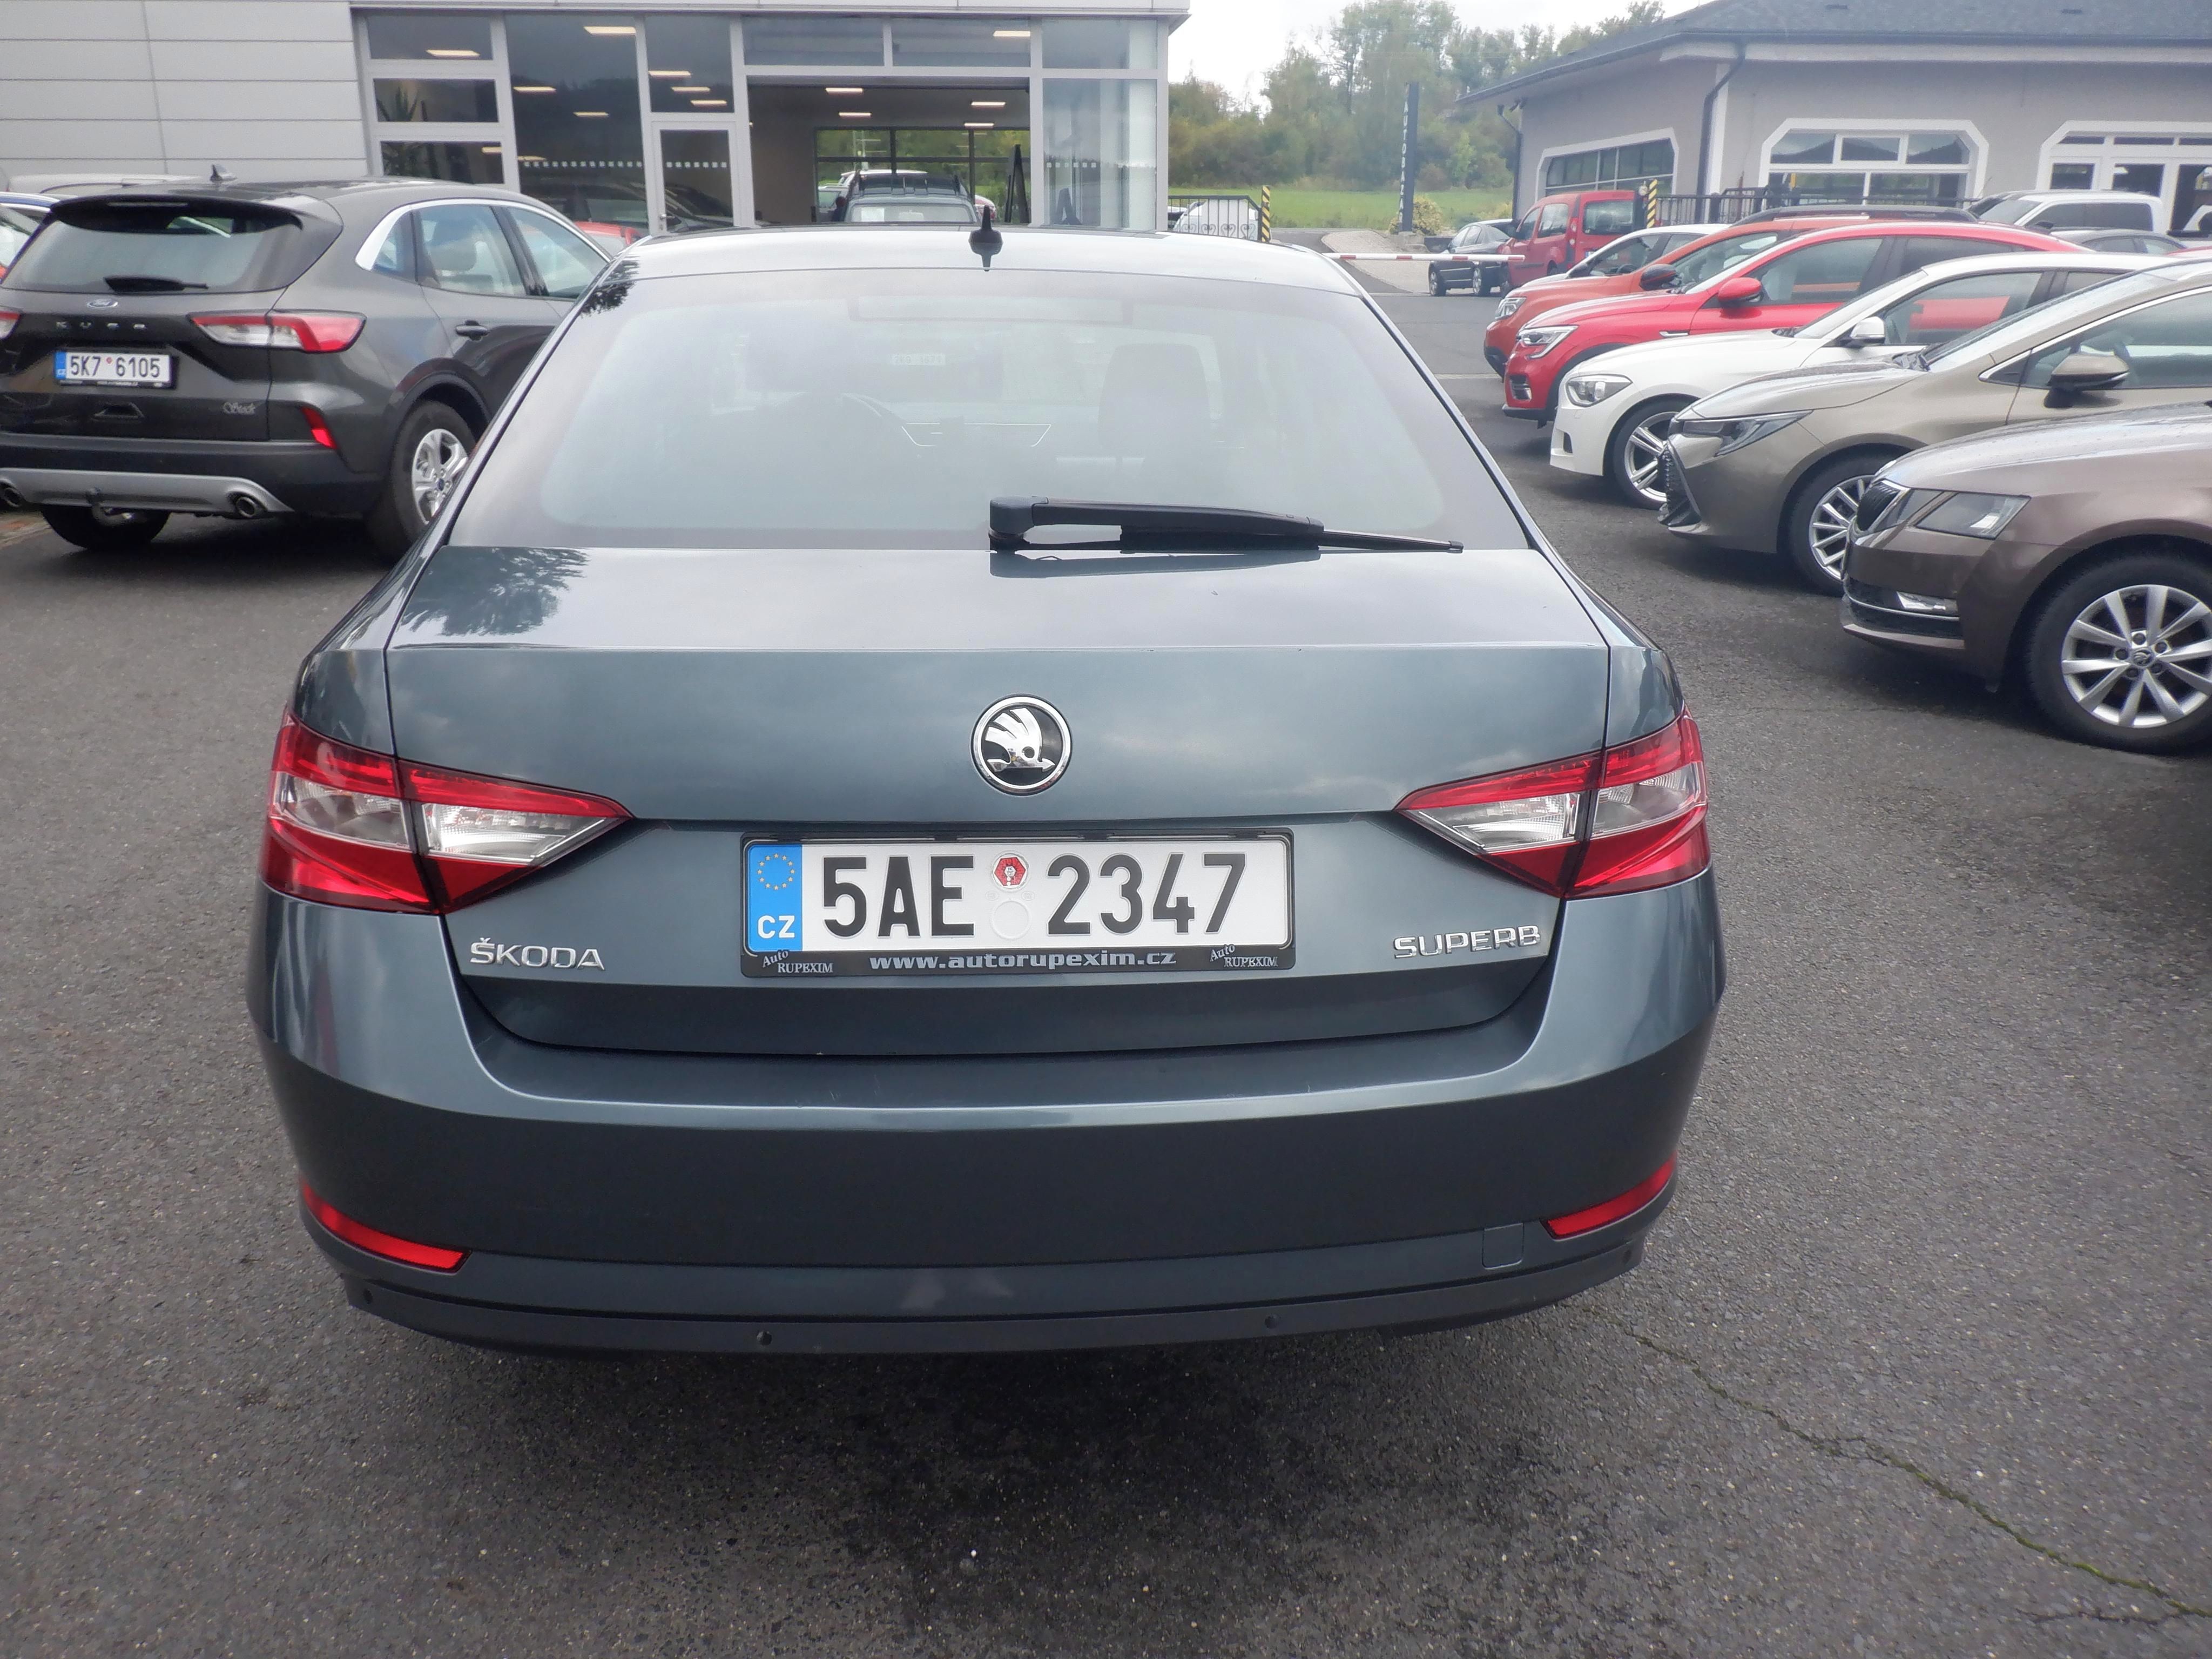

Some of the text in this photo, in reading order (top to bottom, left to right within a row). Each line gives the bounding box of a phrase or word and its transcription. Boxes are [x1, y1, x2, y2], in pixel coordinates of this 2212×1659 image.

[70, 355, 160, 377] 5K7 6105
[822, 853, 1246, 938] 5AE 2347
[757, 915, 795, 939] CZ
[1394, 924, 1541, 959] SUPERB
[470, 936, 605, 971] ŠKODA
[762, 950, 789, 968] Auto
[869, 949, 1177, 970] www.autorupexim.cz
[1209, 944, 1236, 962] Auto
[1223, 956, 1279, 968] RUPEXIM
[777, 962, 834, 973] RUPEXIM
